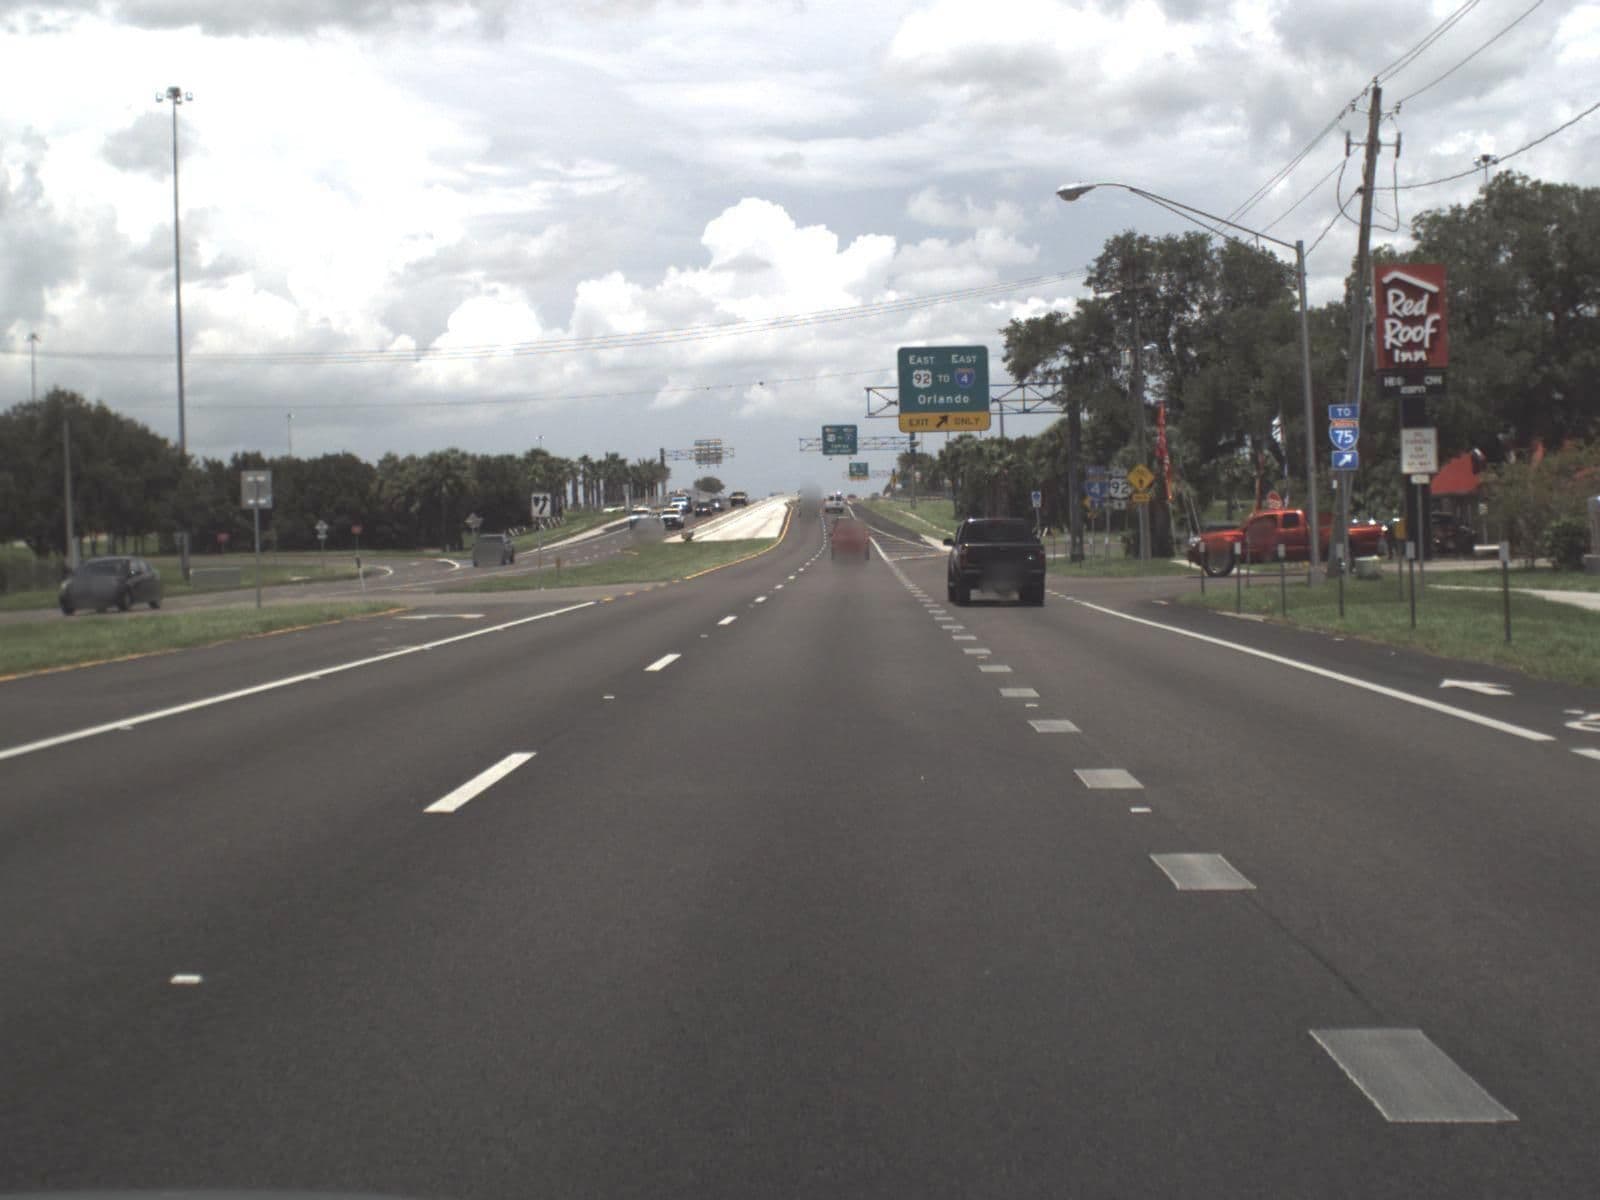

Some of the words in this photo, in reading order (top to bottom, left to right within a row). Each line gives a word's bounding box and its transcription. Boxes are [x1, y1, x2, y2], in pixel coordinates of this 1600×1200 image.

[1387, 288, 1429, 317] Red
[1384, 314, 1441, 350] Roof
[908, 355, 935, 365] EAST
[951, 354, 977, 364] EAST
[1393, 349, 1428, 363] Inn
[914, 373, 930, 384] 92
[937, 375, 950, 383] TO
[960, 374, 968, 383] 4
[918, 394, 970, 405] Orlando
[1337, 407, 1351, 417] TO
[908, 418, 929, 427] EXIT
[954, 417, 980, 425] ONLY
[1335, 430, 1354, 444] 75
[1090, 482, 1100, 494] 4
[1111, 481, 1128, 494] 92
